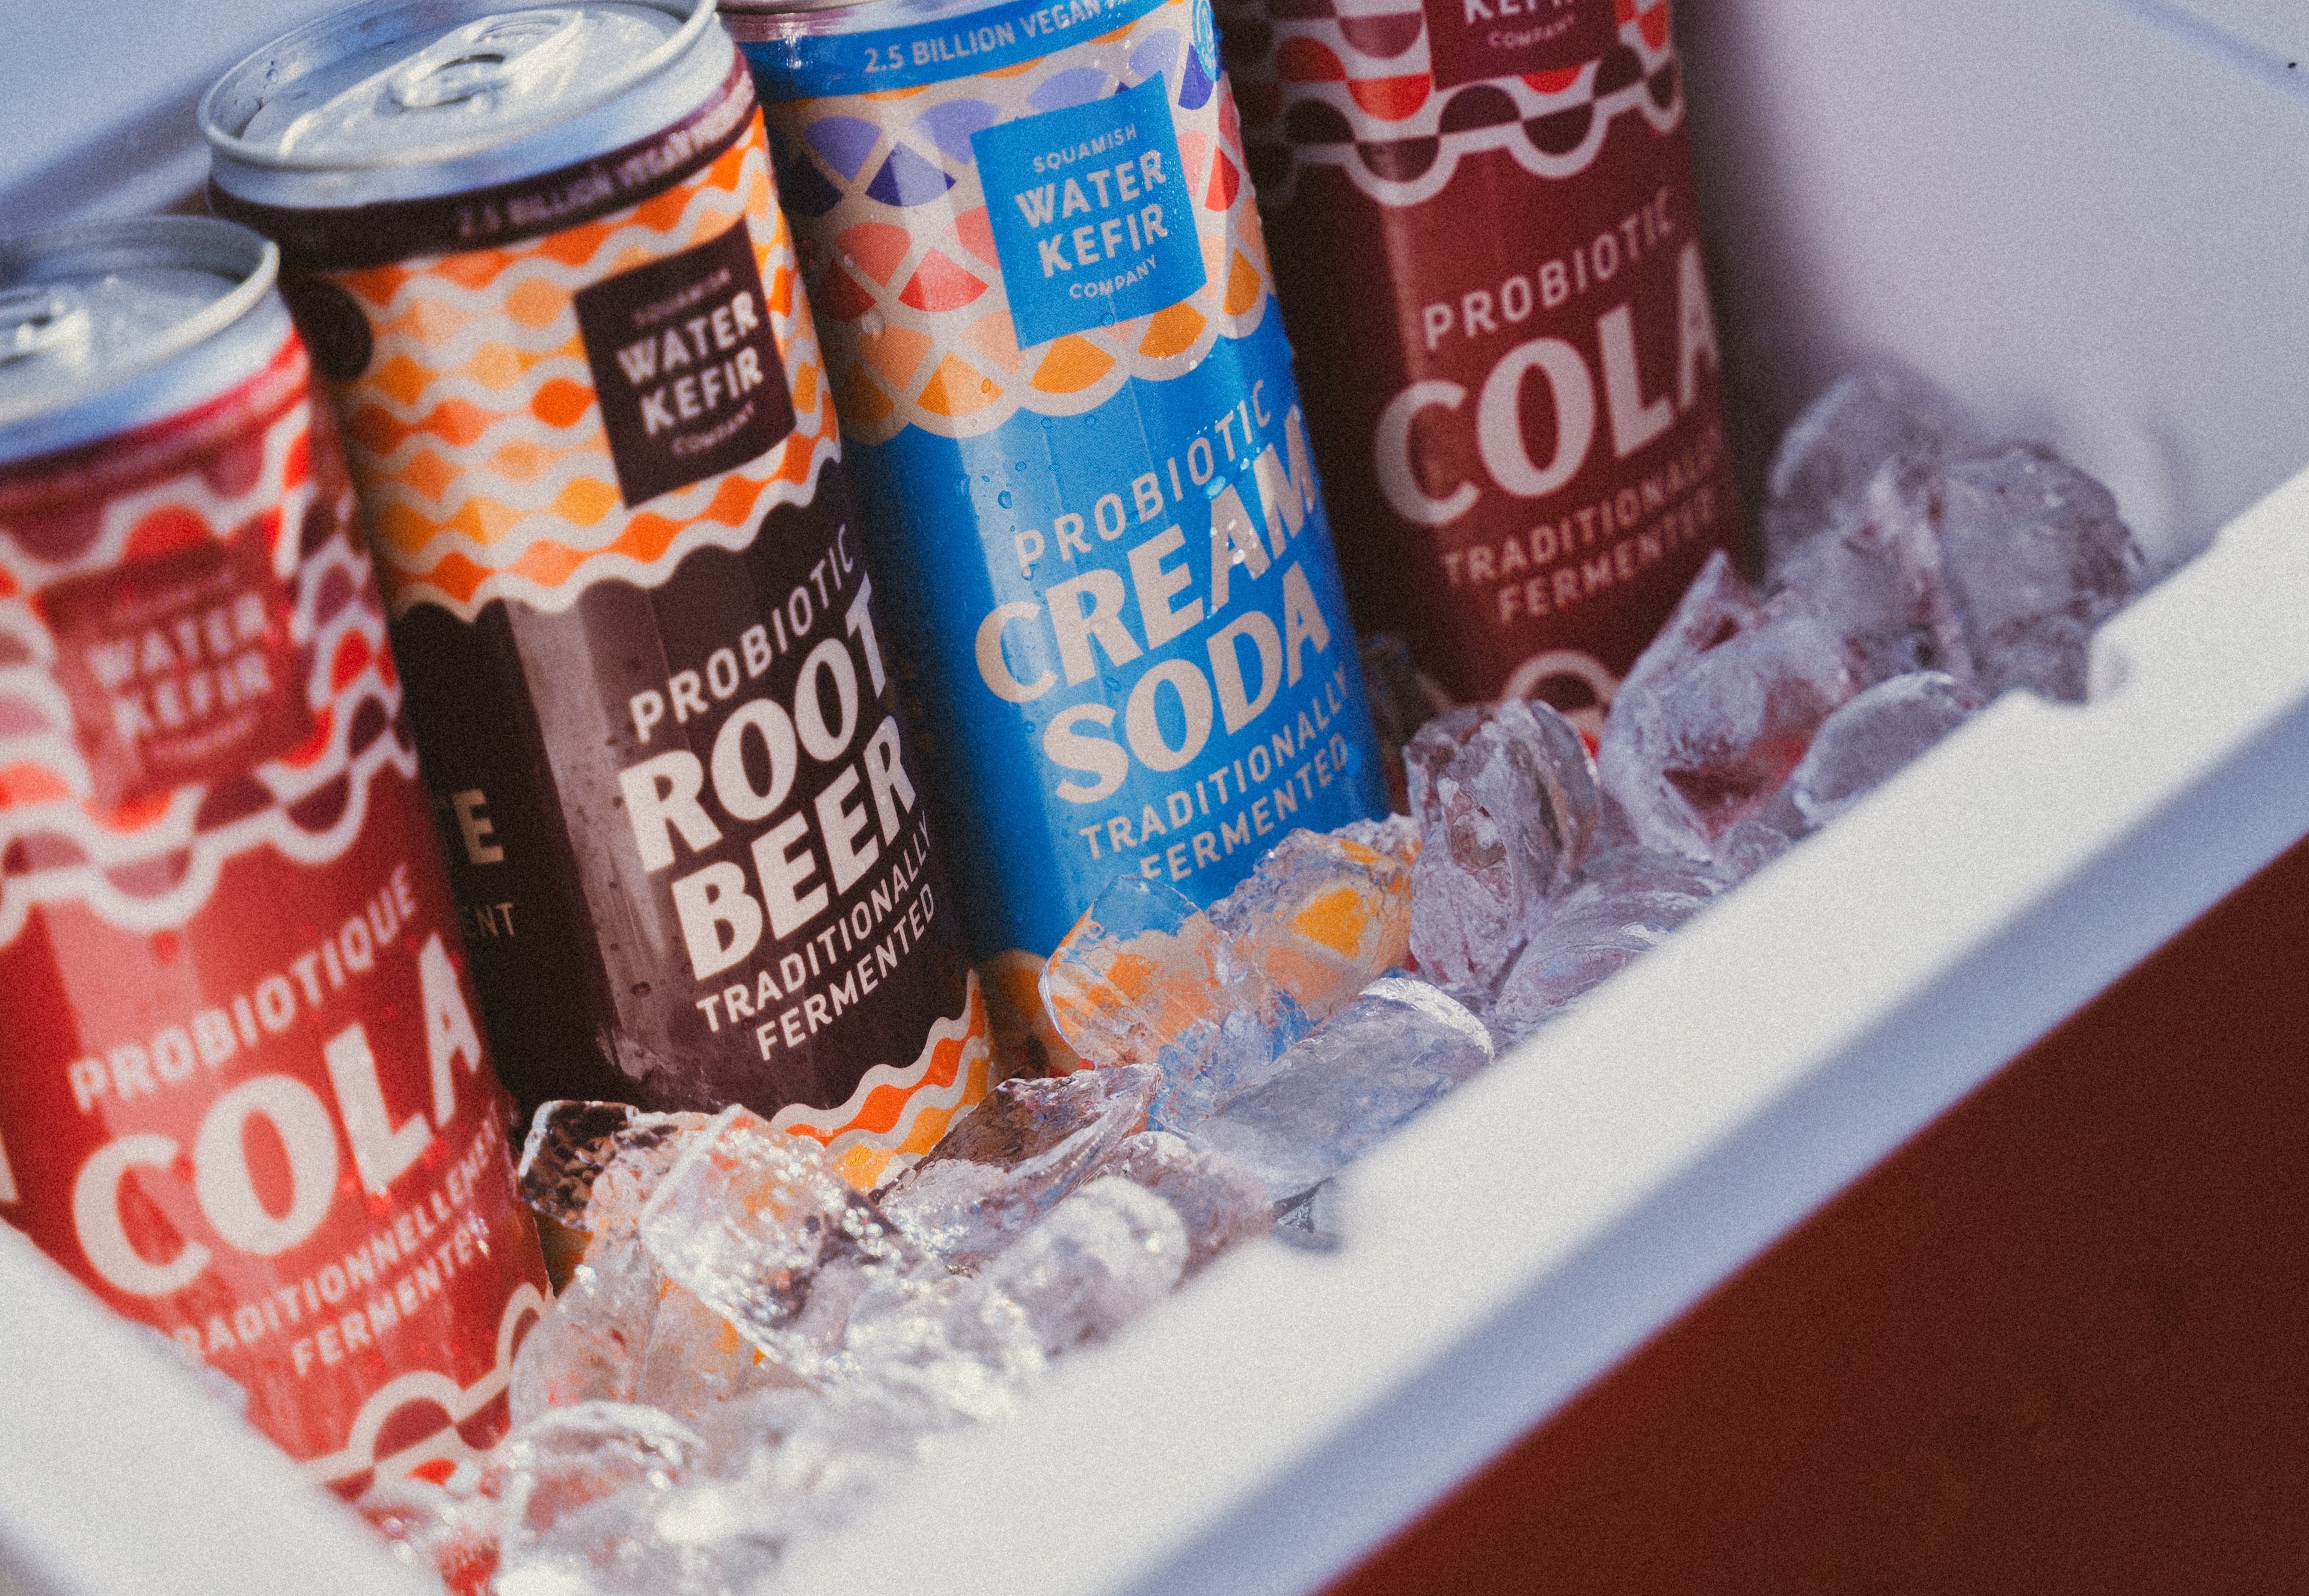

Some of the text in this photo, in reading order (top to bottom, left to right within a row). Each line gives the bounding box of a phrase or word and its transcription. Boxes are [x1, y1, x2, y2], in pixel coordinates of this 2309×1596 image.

[863, 0, 1101, 73] 2.5 BILLION VEGAN
[1014, 149, 1167, 228] WATER
[1032, 123, 1137, 173] SQUAMISH
[1037, 203, 1168, 279] KEFIR
[616, 290, 759, 385] WATER
[1069, 254, 1157, 299] COMPANY
[1421, 185, 1675, 352] PROBIOTIC
[640, 346, 764, 436] KEFIR
[1014, 379, 1271, 577] PROBIOTIC
[1375, 240, 1719, 525] COLA
[629, 524, 853, 745] PROBIOTIC
[974, 403, 1316, 703] CREAM
[619, 570, 886, 872] ROOT
[1042, 561, 1332, 804] SODA
[1078, 661, 1349, 860] TRADITIONALLY
[670, 715, 917, 981] BEER
[1139, 733, 1348, 881] FERMENTED
[69, 864, 417, 1114] PROBIOTIQUE
[696, 809, 931, 1033] TRADITIONALLY
[755, 883, 934, 1062] FERMENTED
[72, 931, 481, 1298] COLA
